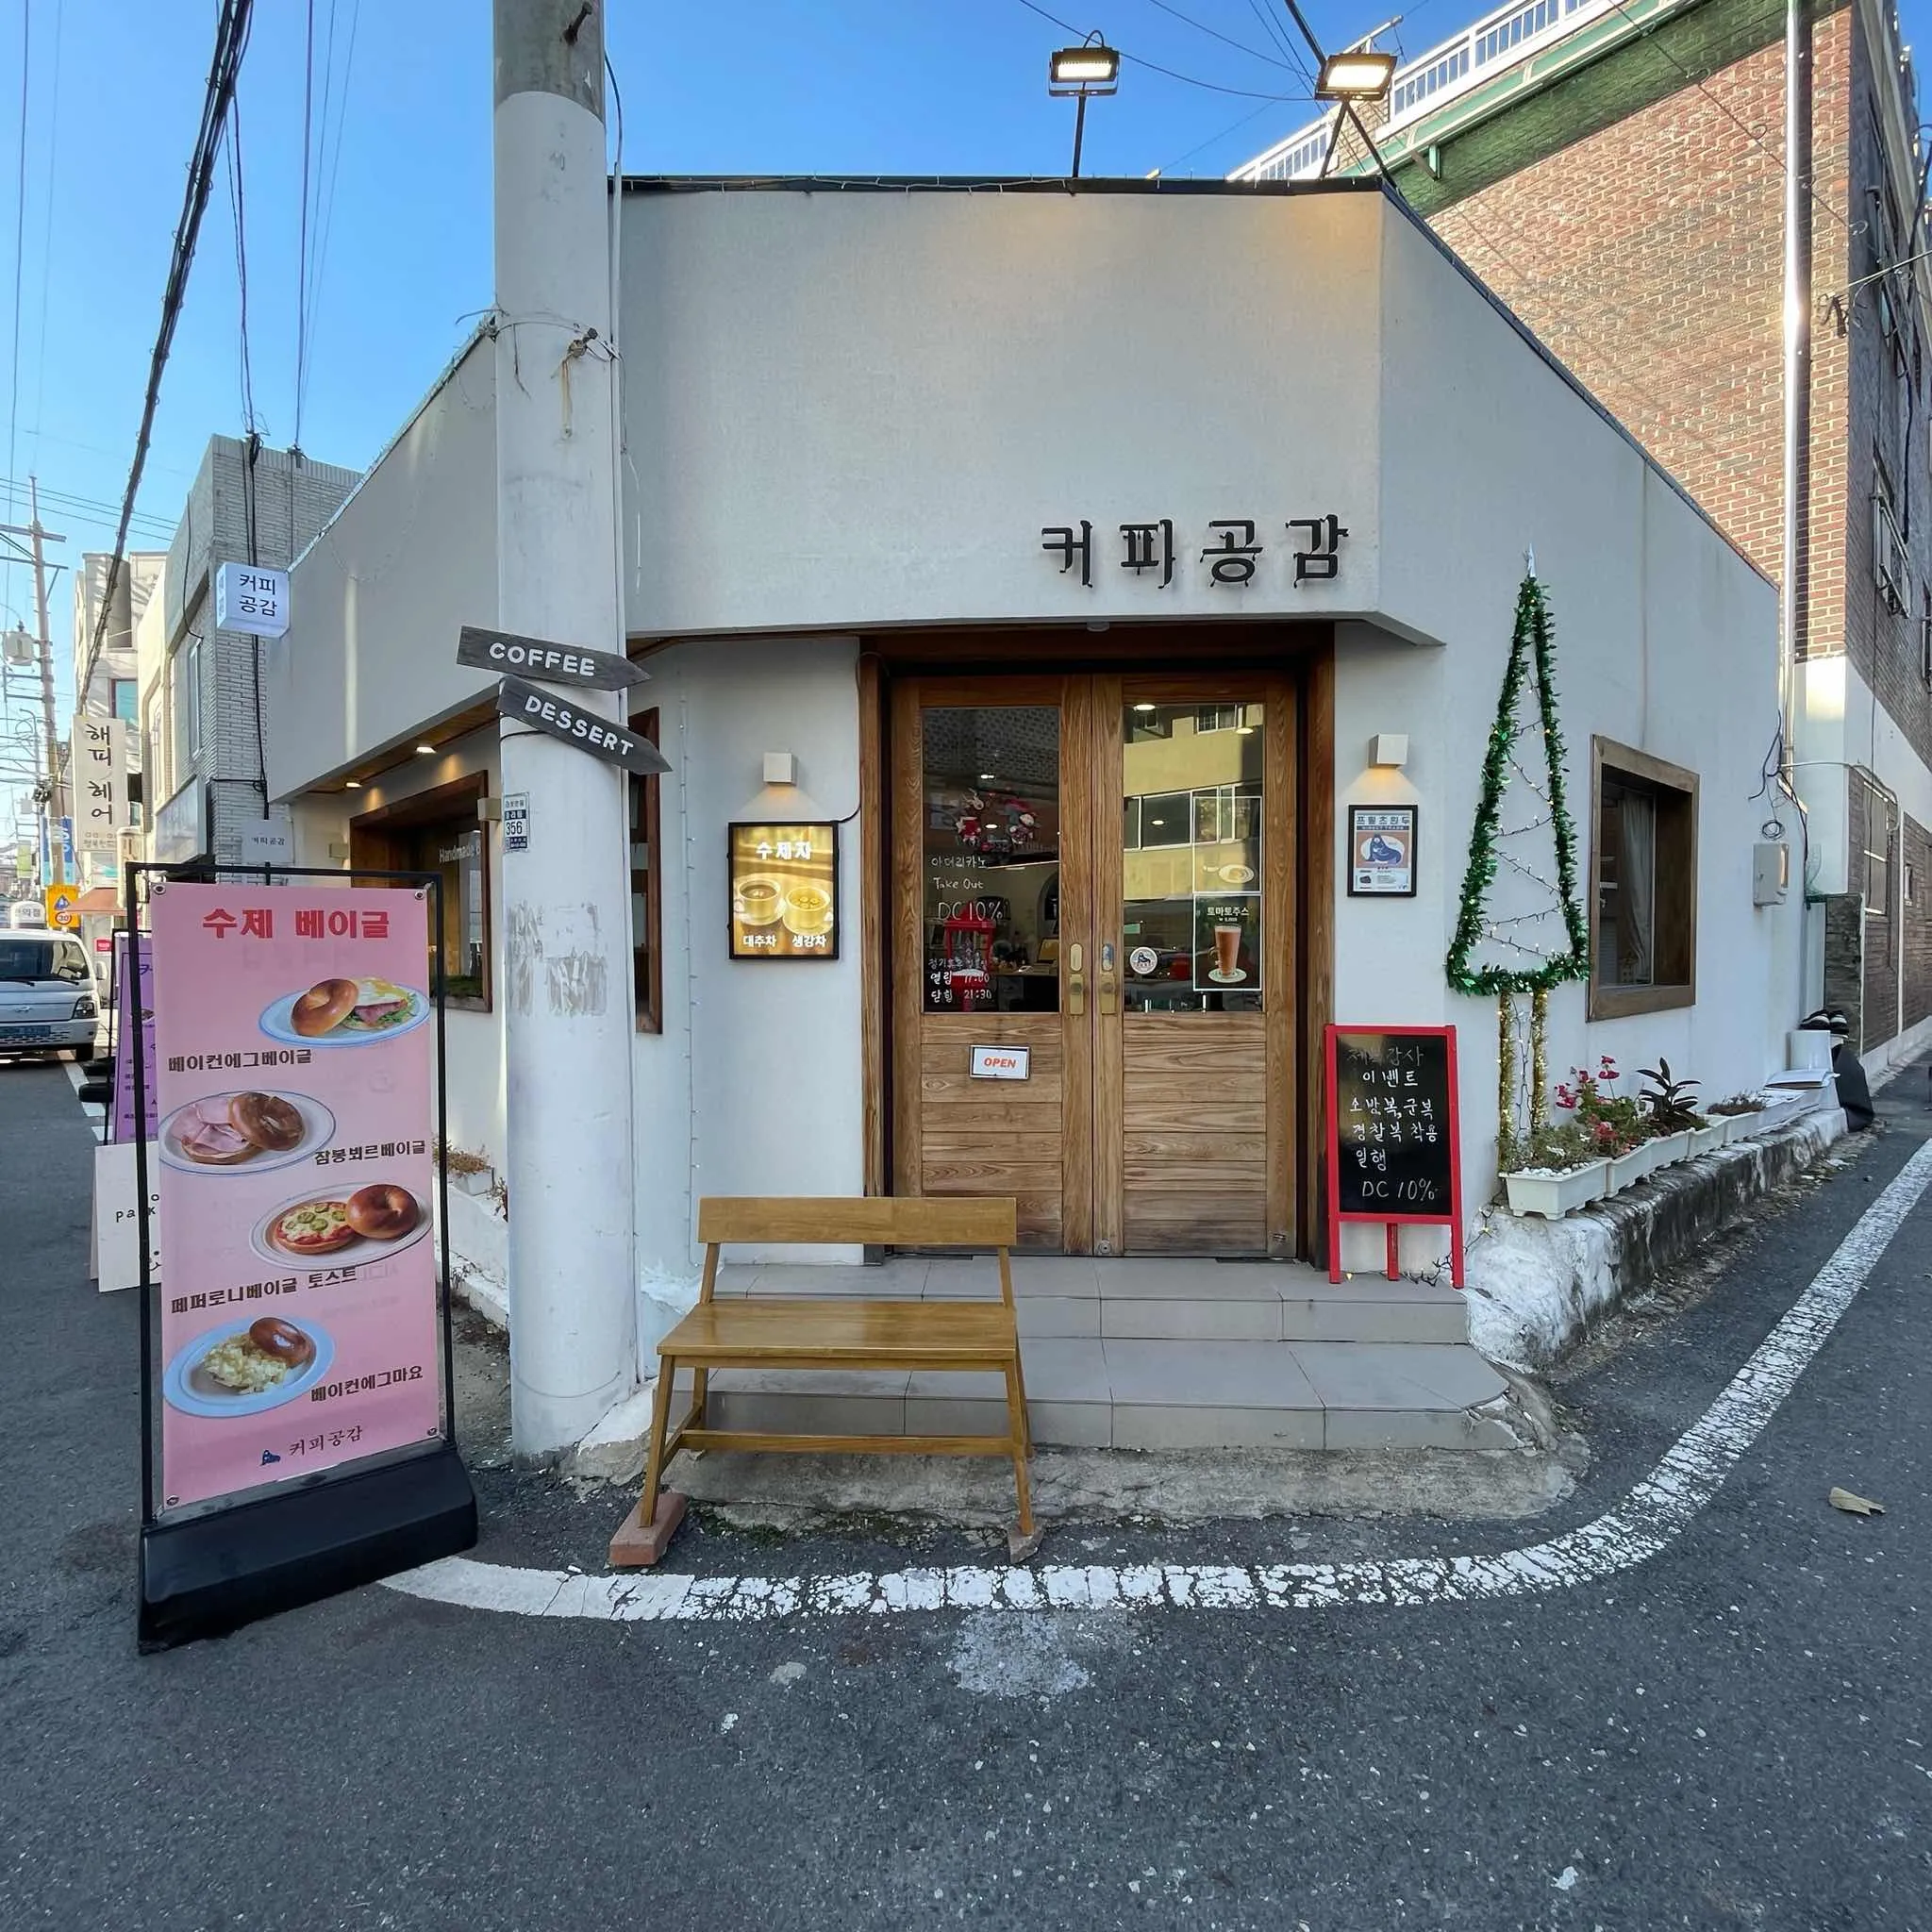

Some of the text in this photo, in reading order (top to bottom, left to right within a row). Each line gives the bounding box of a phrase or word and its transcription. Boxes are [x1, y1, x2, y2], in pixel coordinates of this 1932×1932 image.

[1041, 514, 1349, 589] 커피공감
[240, 574, 275, 595] 커피
[239, 595, 277, 617] 공감
[489, 642, 595, 676] COFFEE
[525, 695, 634, 756] DESSERT
[87, 780, 112, 824] 헤어
[506, 822, 522, 835] 356
[756, 841, 810, 859] 수제차
[933, 877, 984, 890] Take Out
[938, 901, 1003, 921] DC 10%
[1208, 907, 1249, 916] 토마토주스
[203, 908, 389, 939] 수제 베이글
[742, 935, 776, 948] 대추차
[930, 971, 953, 985] 열림
[964, 990, 991, 999] 21:30
[169, 1049, 311, 1072] 베이컨에그베이글
[984, 1058, 1016, 1068] OPEN
[1387, 1045, 1424, 1066] 감사
[1362, 1069, 1418, 1087] 이벤트
[1353, 1123, 1439, 1142] 경찰복 착용
[315, 1141, 425, 1165] 잠봉뵈르베이글
[1357, 1147, 1387, 1172] 일행
[1362, 1178, 1437, 1202] DC 10%
[171, 1267, 357, 1313] 페퍼로니베이글 토스트
[311, 1365, 423, 1402] 베이컨에그마요
[290, 1425, 362, 1456] 커피공감
